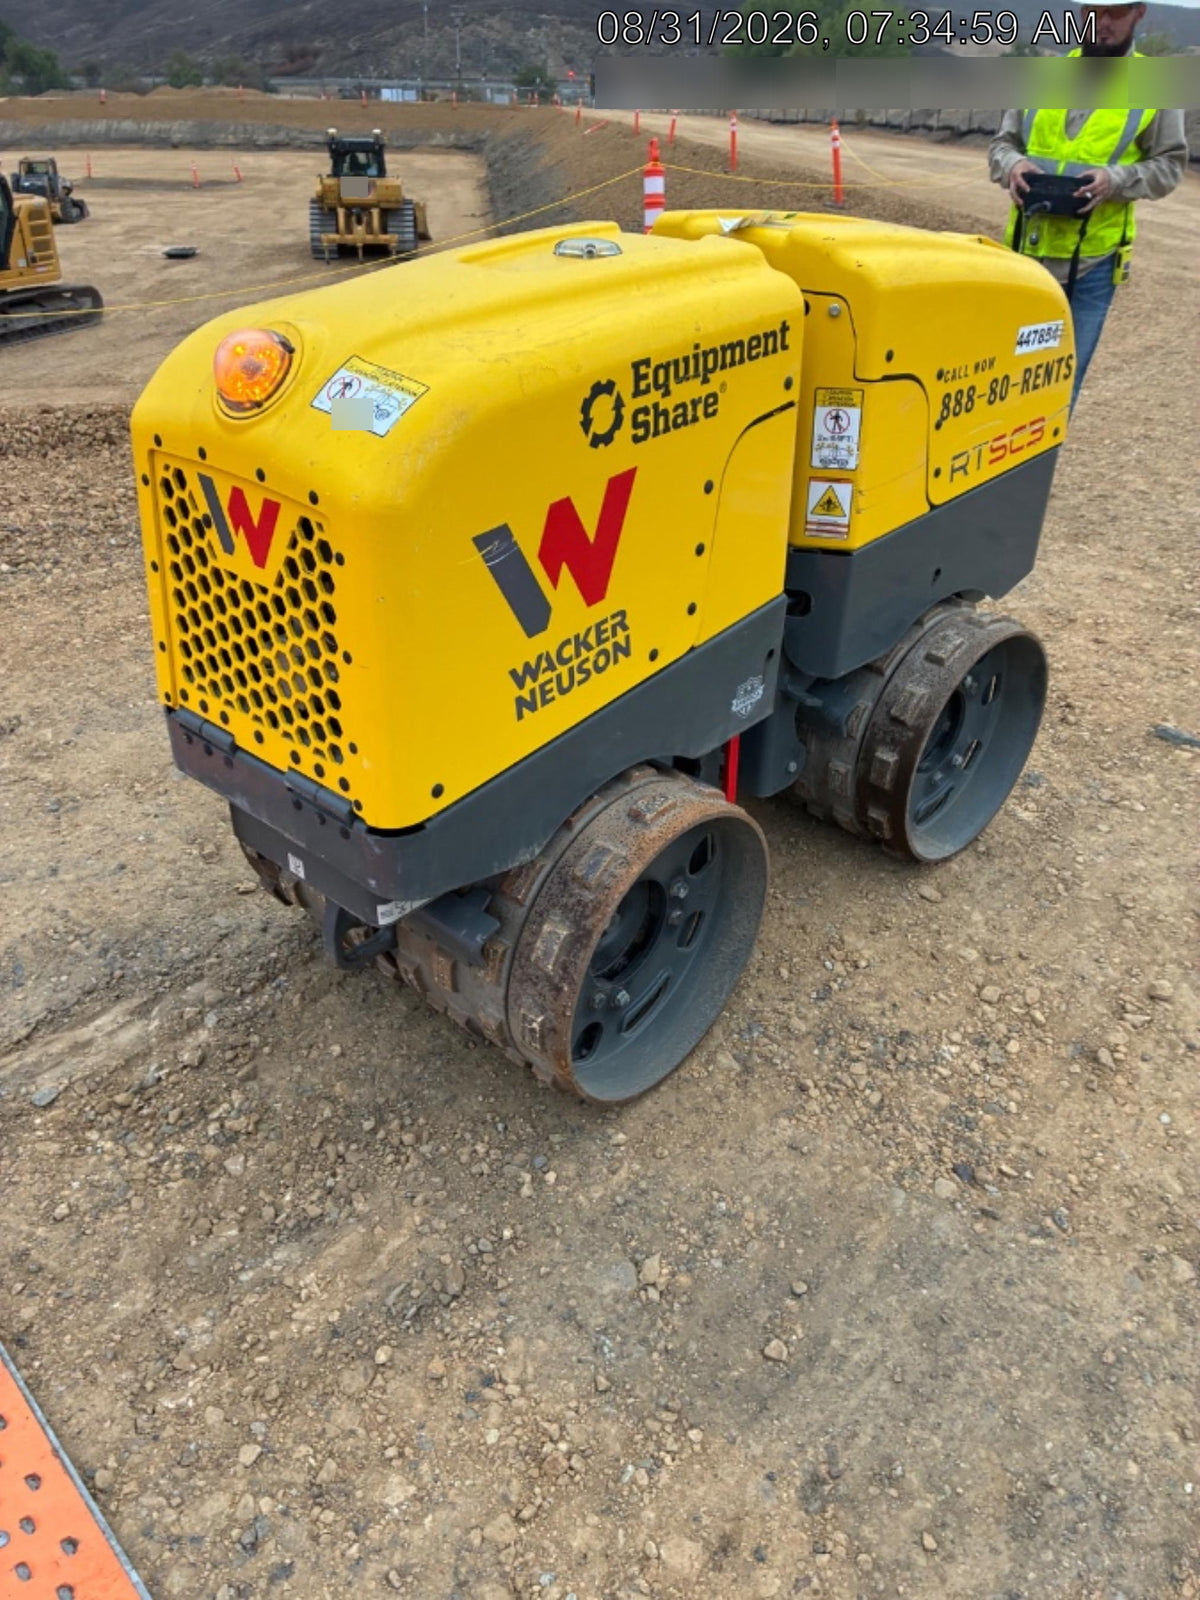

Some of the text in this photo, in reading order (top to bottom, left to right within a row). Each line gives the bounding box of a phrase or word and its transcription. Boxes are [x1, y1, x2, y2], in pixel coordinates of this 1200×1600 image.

[631, 320, 790, 398] Equipment
[940, 354, 1074, 422] 888-80-RENTS
[943, 356, 996, 383] CALL NOW
[631, 391, 718, 444] Share
[508, 609, 630, 691] WACKER
[514, 634, 631, 721] NEUSON
